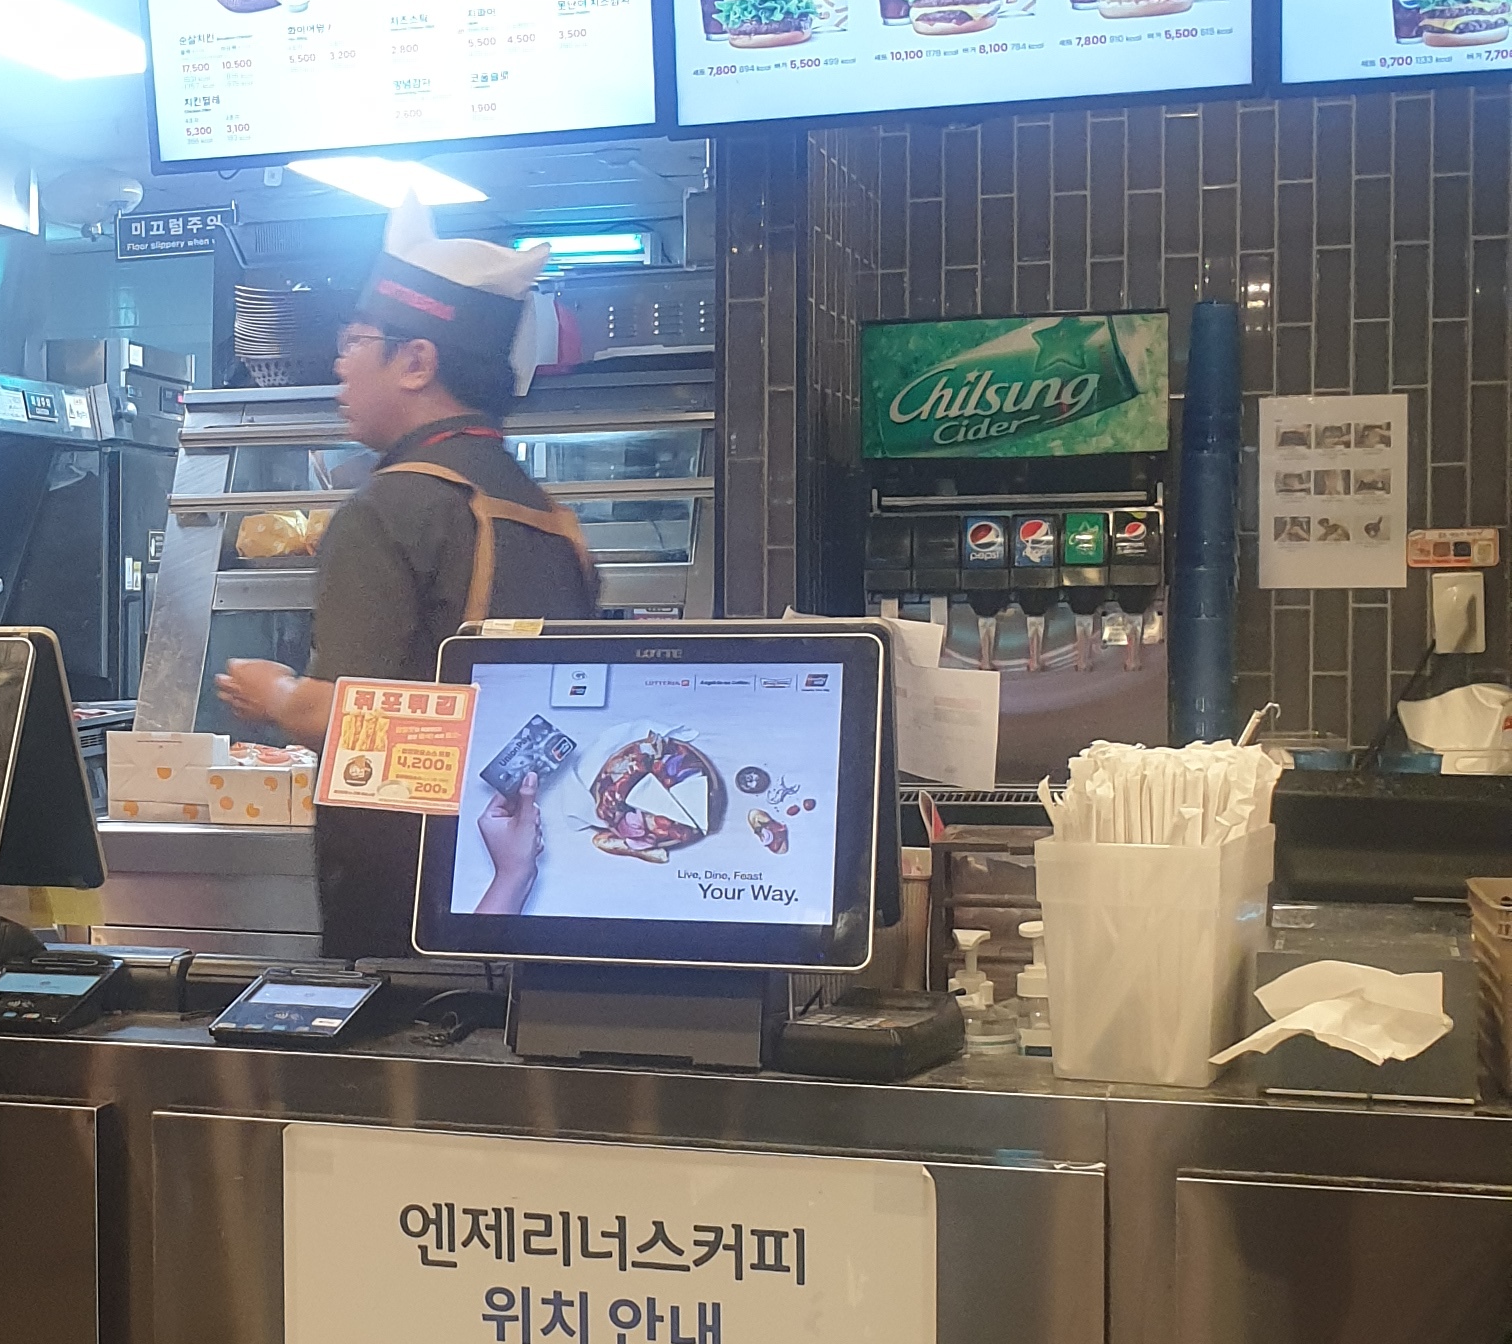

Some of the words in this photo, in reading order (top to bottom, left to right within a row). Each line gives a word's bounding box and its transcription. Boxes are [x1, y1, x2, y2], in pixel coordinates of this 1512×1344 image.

[507, 33, 536, 44] 4,500
[558, 28, 587, 40] 3,500
[1075, 35, 1106, 47] 7,800
[1164, 28, 1198, 41] 5,500
[890, 50, 923, 62] 10,100
[979, 43, 1008, 55] 8,100
[707, 65, 737, 77] 7,800
[790, 58, 820, 70] 5,500
[1379, 56, 1412, 69] 9,700
[227, 123, 250, 133] 3,100
[131, 214, 221, 238] 미끄럼주의
[127, 243, 148, 251] Floor
[151, 241, 185, 250] slippery
[188, 238, 209, 246] when
[889, 363, 1101, 424] Chilsung
[933, 414, 1041, 444] Cider
[970, 551, 1000, 561] pepsi
[635, 649, 683, 658] LOTTE
[499, 735, 533, 767] UnionPay
[678, 869, 702, 880] Live,
[704, 870, 731, 881] Dine,
[734, 871, 763, 881] Feast
[698, 883, 745, 900] Your
[750, 884, 799, 906] Way.
[399, 1202, 807, 1286] 엔제리너스커피
